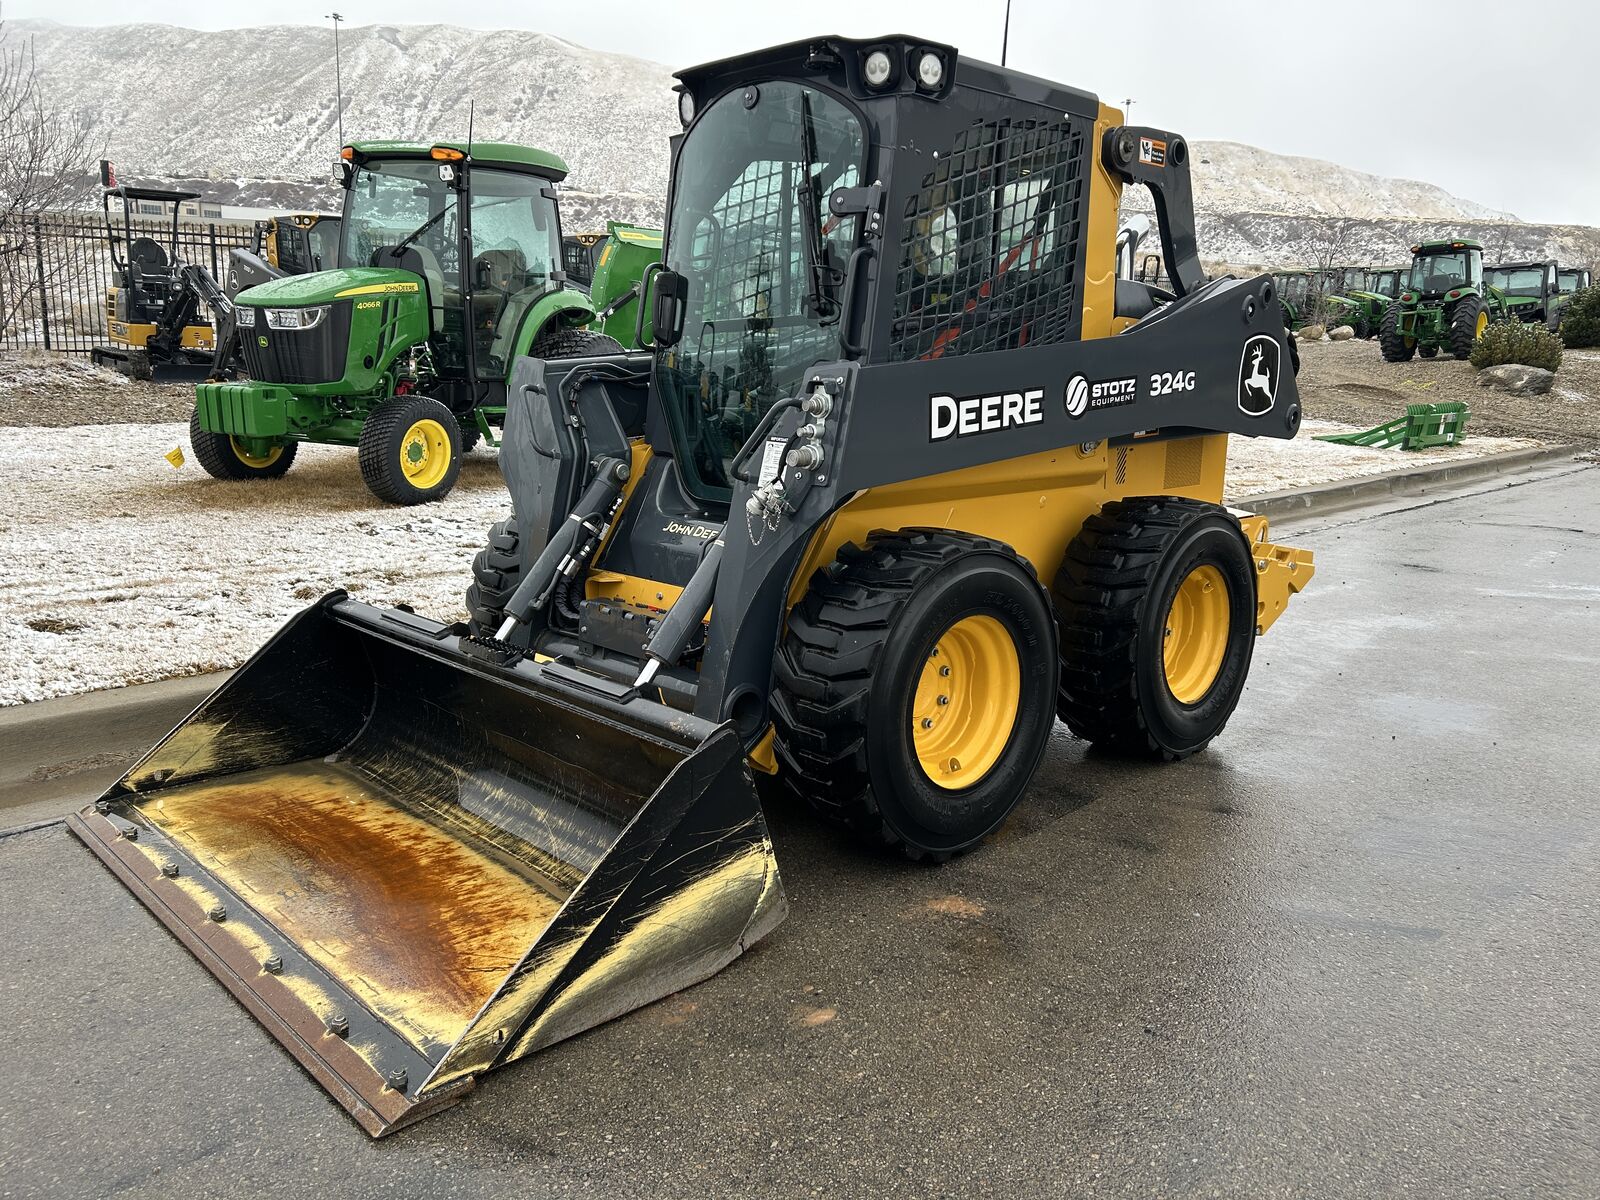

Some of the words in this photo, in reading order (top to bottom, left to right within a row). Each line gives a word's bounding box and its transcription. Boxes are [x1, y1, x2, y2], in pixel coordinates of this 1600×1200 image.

[357, 301, 381, 309] 4066R
[1092, 379, 1136, 398] STOTZ
[1149, 370, 1196, 397] 324G
[1091, 393, 1136, 407] EQUIPMENT
[931, 389, 1044, 439] DEERE
[662, 521, 695, 536] JOHN
[692, 526, 719, 539] DEE
